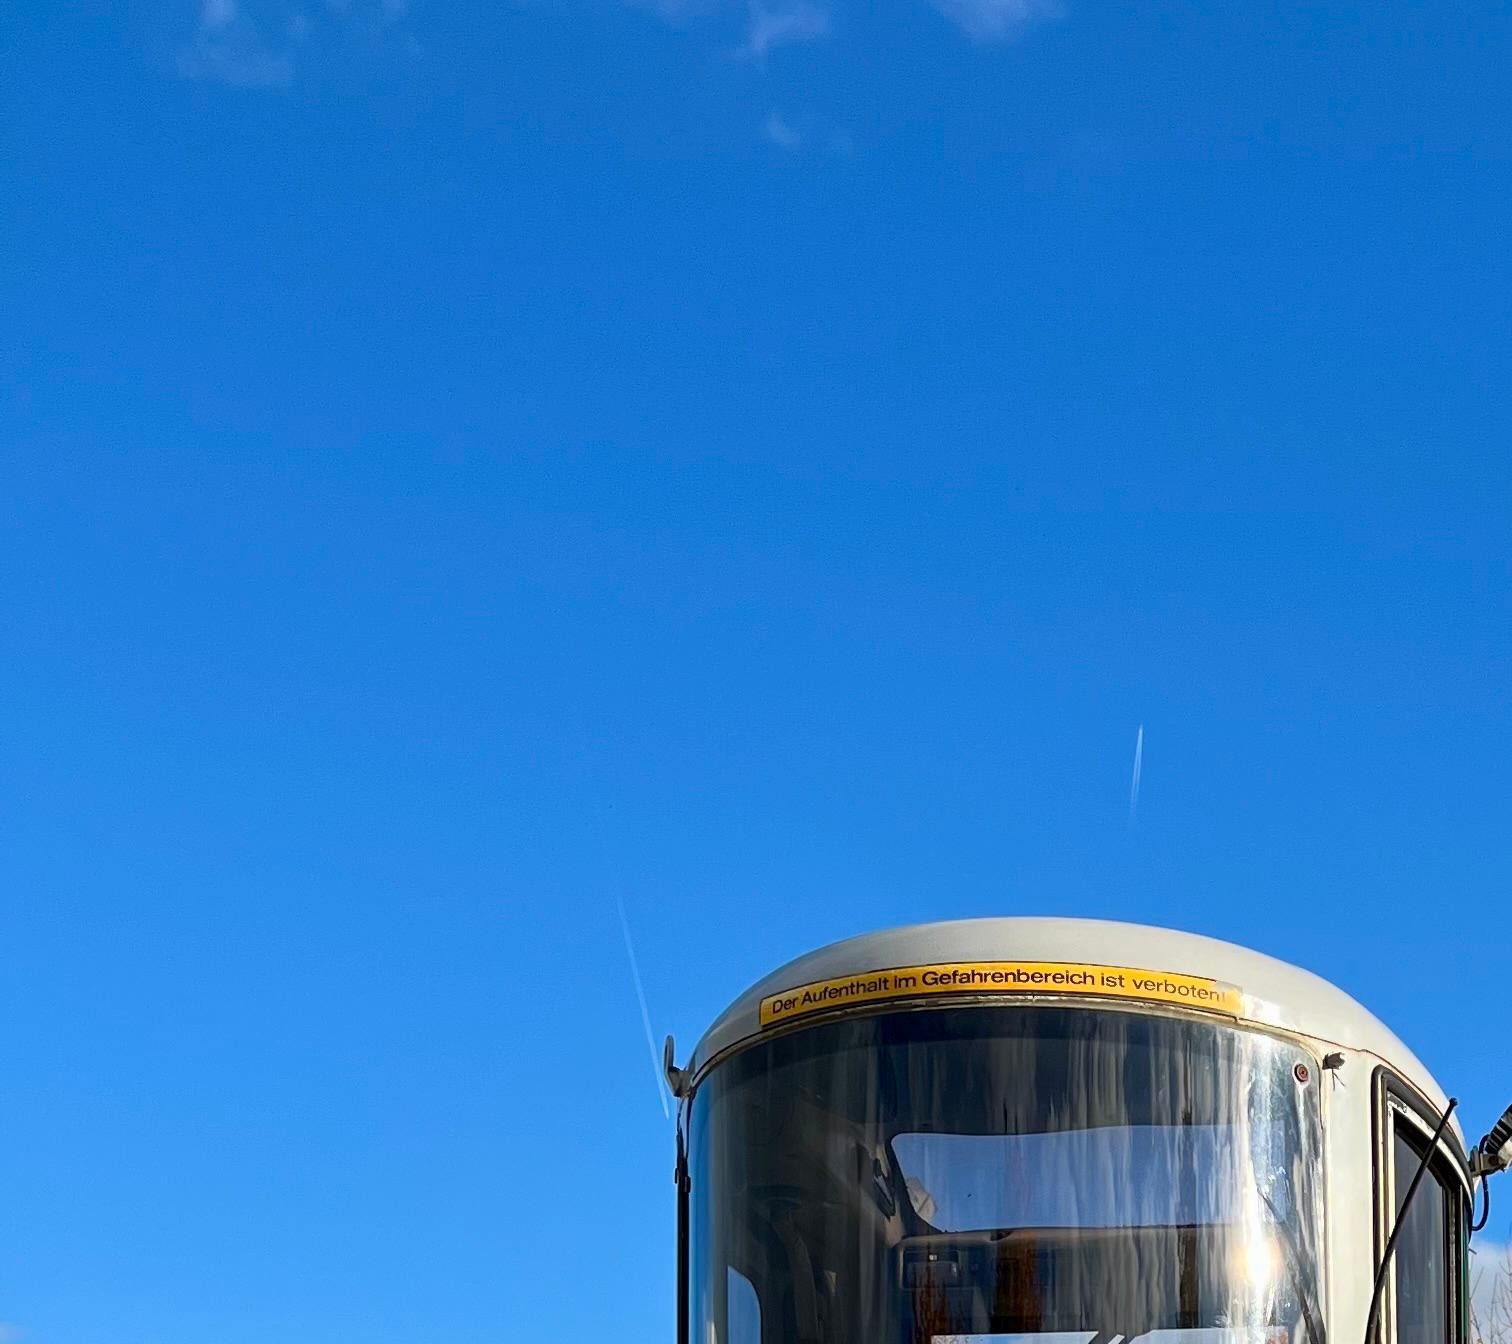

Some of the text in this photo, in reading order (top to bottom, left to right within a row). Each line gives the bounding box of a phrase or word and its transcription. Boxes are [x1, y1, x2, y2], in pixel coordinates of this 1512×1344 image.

[772, 998, 799, 1014] Der
[801, 977, 889, 1006] Aufenthalt
[894, 975, 917, 989] im
[921, 969, 1095, 986] Gefahrenbereich
[1101, 973, 1125, 988] ist
